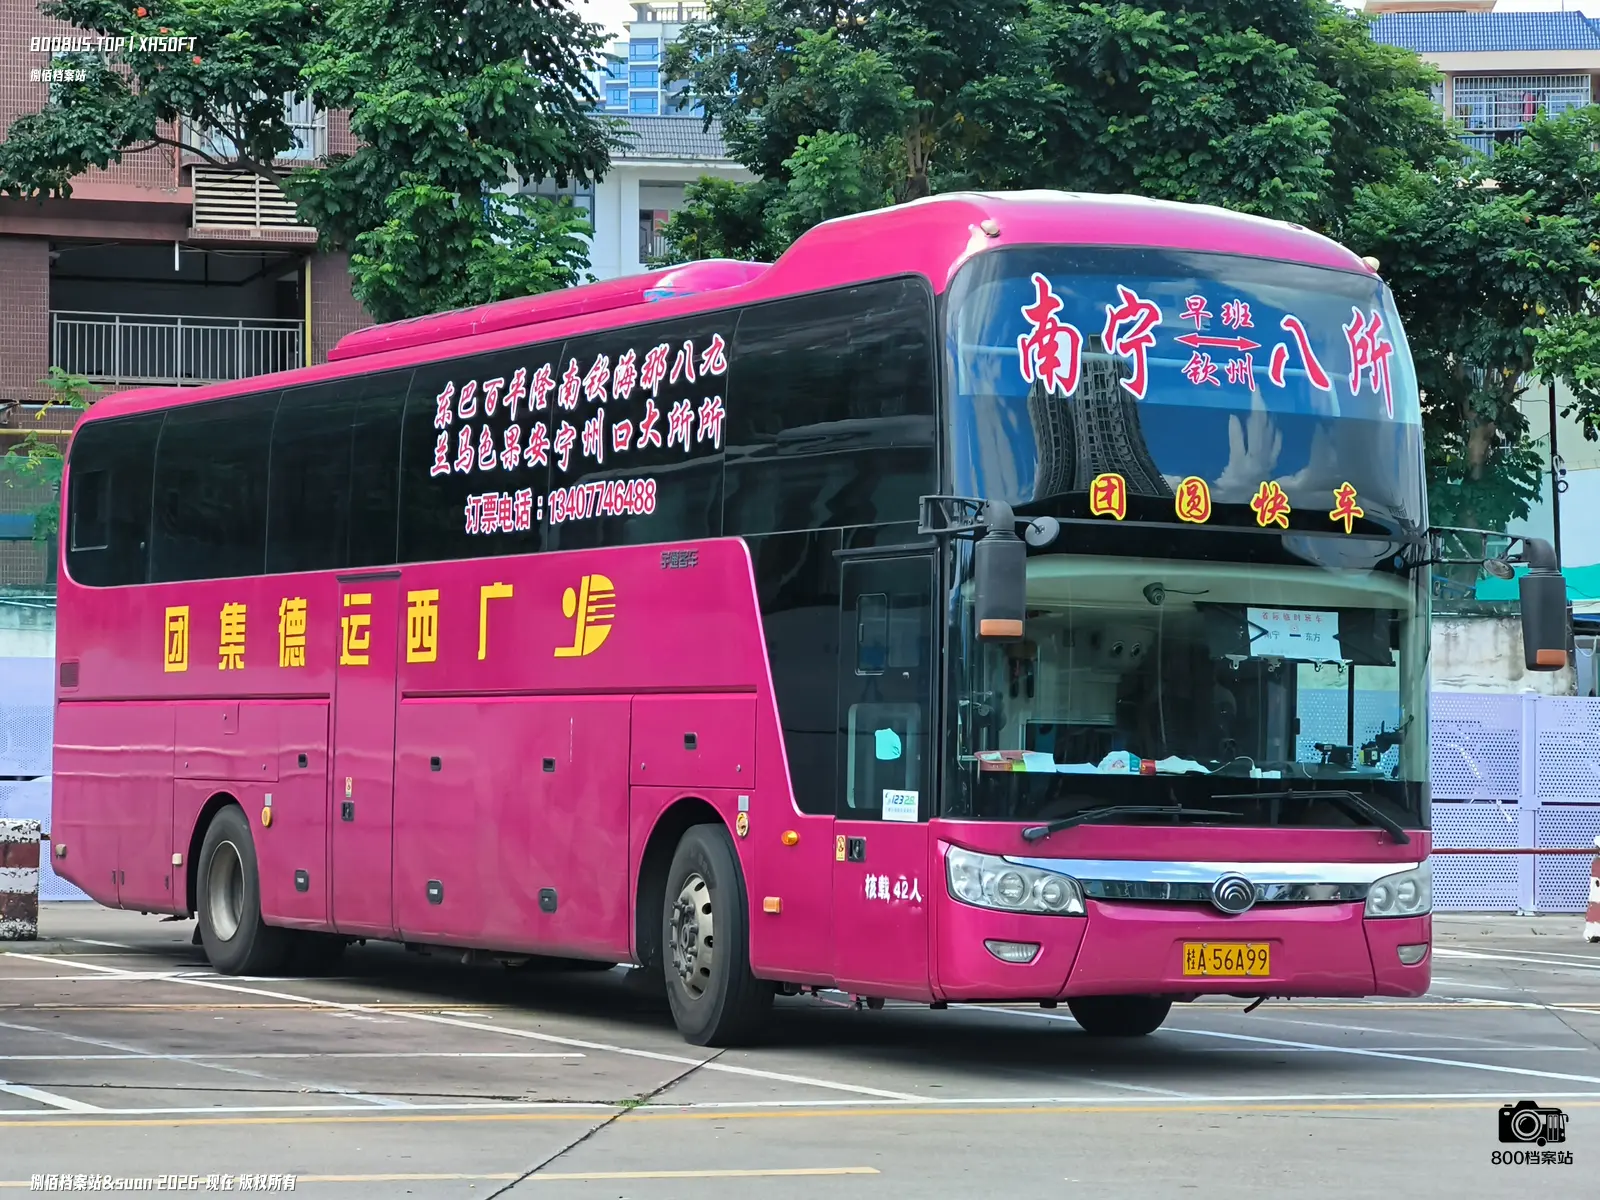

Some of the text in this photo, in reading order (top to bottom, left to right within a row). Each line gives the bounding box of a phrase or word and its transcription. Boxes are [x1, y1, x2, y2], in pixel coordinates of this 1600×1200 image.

[1017, 272, 1163, 399] 南宁
[1179, 295, 1255, 330] 早班
[1182, 351, 1256, 392] 钦州
[1268, 306, 1394, 419] 八所
[1090, 473, 1363, 534] 团圆快车
[892, 794, 916, 806] 12328
